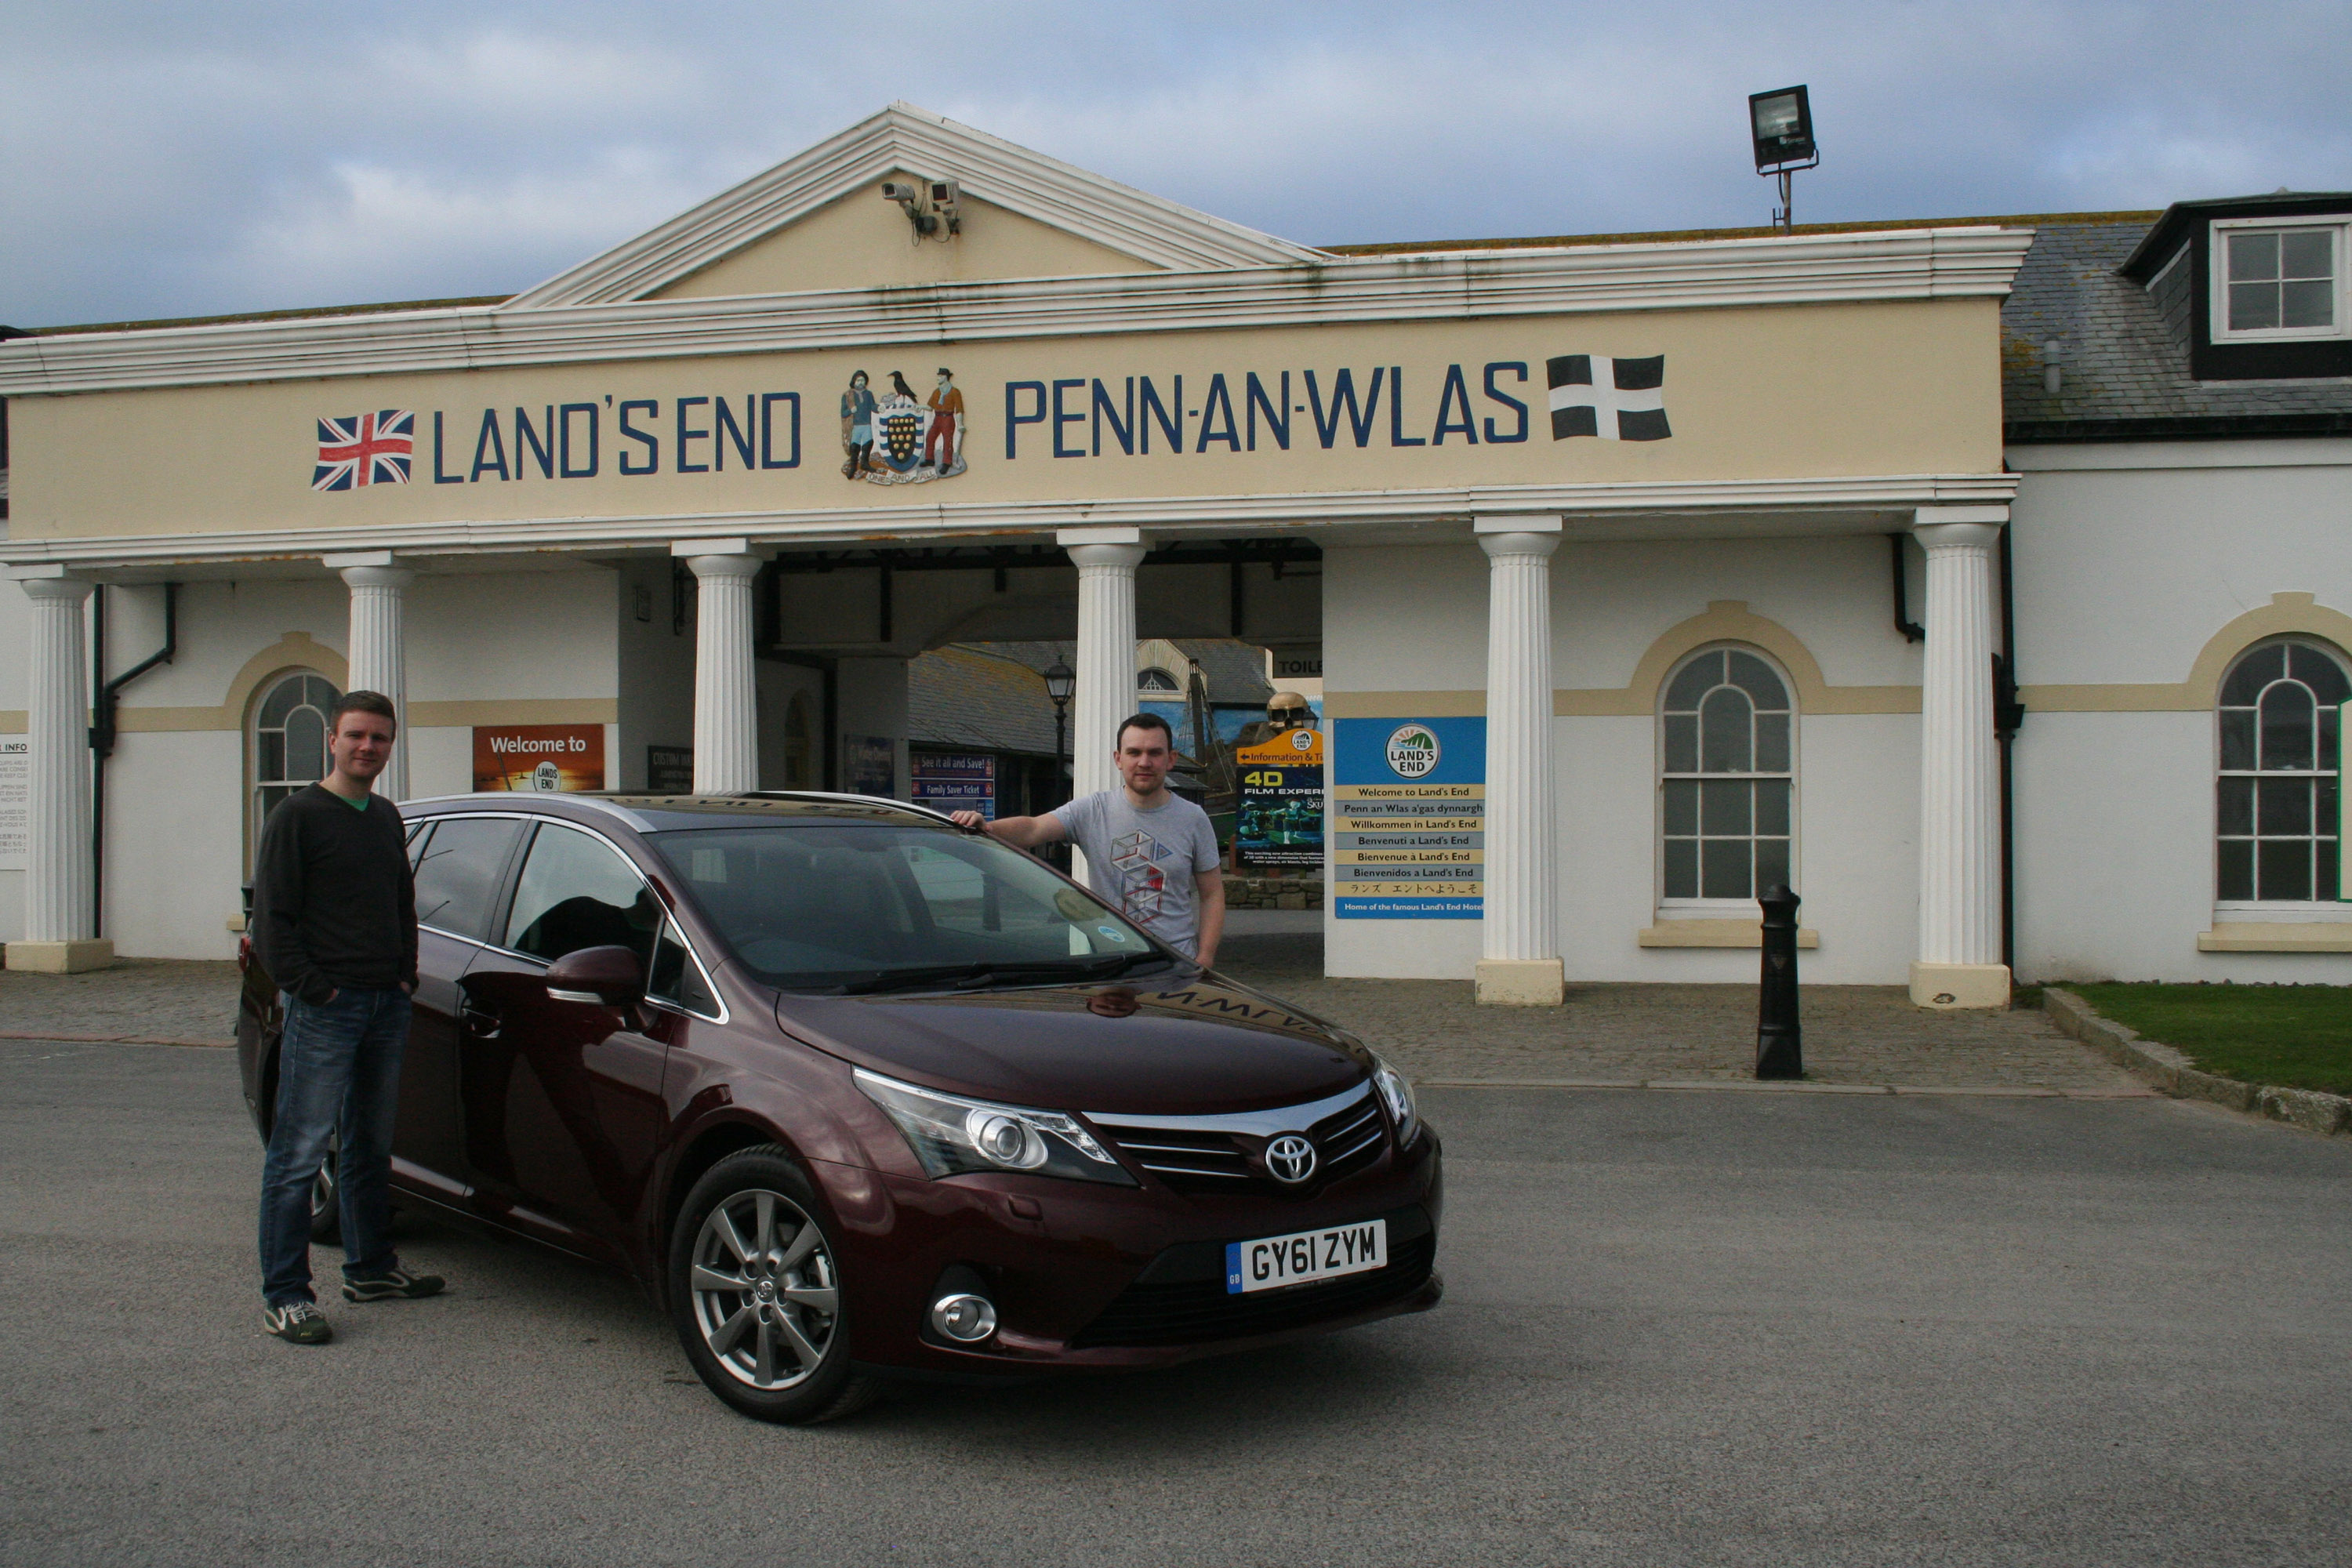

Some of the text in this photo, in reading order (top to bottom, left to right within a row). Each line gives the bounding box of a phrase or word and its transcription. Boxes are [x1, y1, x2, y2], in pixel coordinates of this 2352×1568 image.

[434, 361, 1530, 485] LAND'S END PENN-AN-WLAS
[869, 470, 935, 484] ONE AND ALL
[5, 743, 27, 752] INFO
[490, 735, 586, 753] Welcome to
[1251, 753, 1303, 761] Information
[1305, 753, 1313, 761] &
[1391, 750, 1434, 761] LAND'S
[921, 757, 935, 768] See
[935, 757, 942, 768] it
[942, 757, 951, 768] all
[953, 757, 966, 768] and
[967, 758, 985, 769] Save!
[1399, 761, 1425, 771] END
[541, 779, 554, 789] END
[1245, 771, 1283, 786] 4D
[927, 785, 946, 796] Family
[947, 785, 963, 794] Saver
[964, 785, 979, 794] Ticket
[1359, 788, 1402, 797] Welcome
[1418, 788, 1448, 797] Land's
[1345, 804, 1368, 813] Penn
[1412, 804, 1435, 815] a'gas
[1438, 804, 1483, 815] dynnargh
[1351, 820, 1411, 829] Willkommen
[1358, 837, 1406, 845] Benvenuti
[1410, 852, 1416, 861] à
[1419, 852, 1449, 861] Land's
[1452, 852, 1470, 861] End
[1423, 868, 1452, 877] Land's
[1455, 868, 1474, 877] End
[1252, 1225, 1376, 1281] GY61 ZYM
[1229, 1273, 1240, 1284] GB
